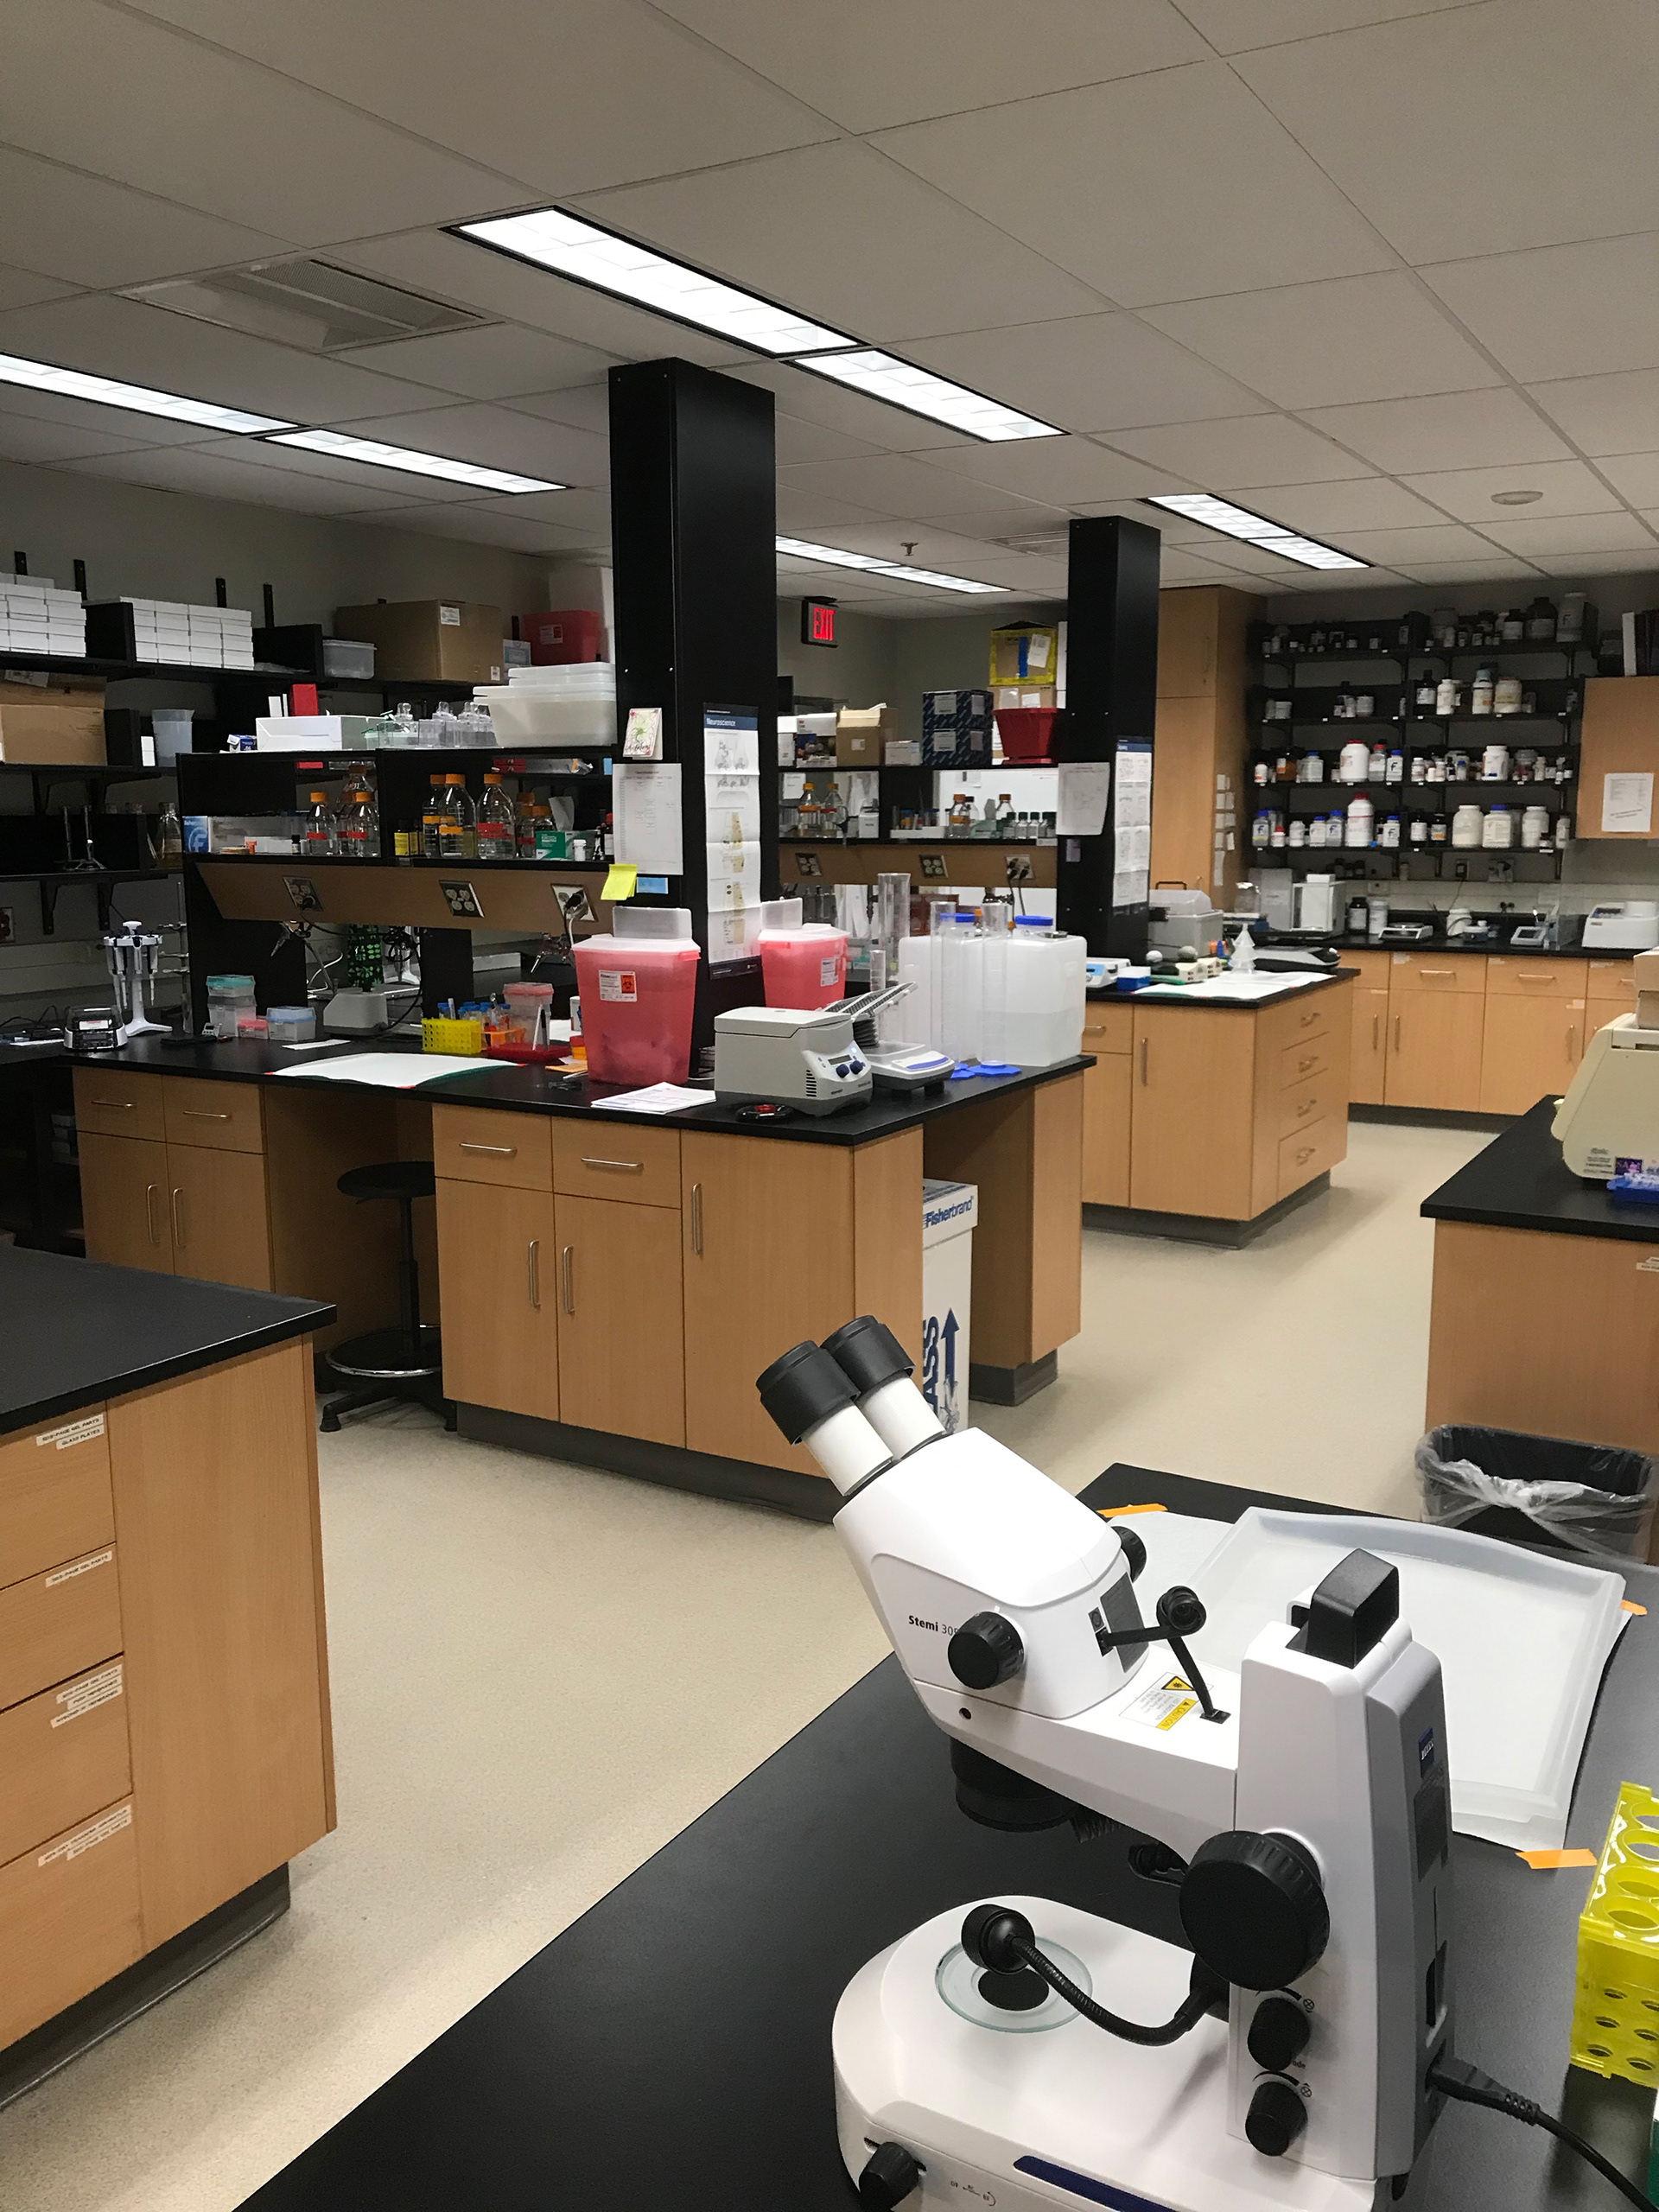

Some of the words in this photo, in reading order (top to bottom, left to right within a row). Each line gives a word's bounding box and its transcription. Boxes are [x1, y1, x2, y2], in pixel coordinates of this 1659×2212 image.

[814, 607, 835, 640] EXIT
[925, 1196, 974, 1228] Fisherbrand
[908, 1615, 938, 1632] Stemi
[1292, 2060, 1306, 2069] ode
